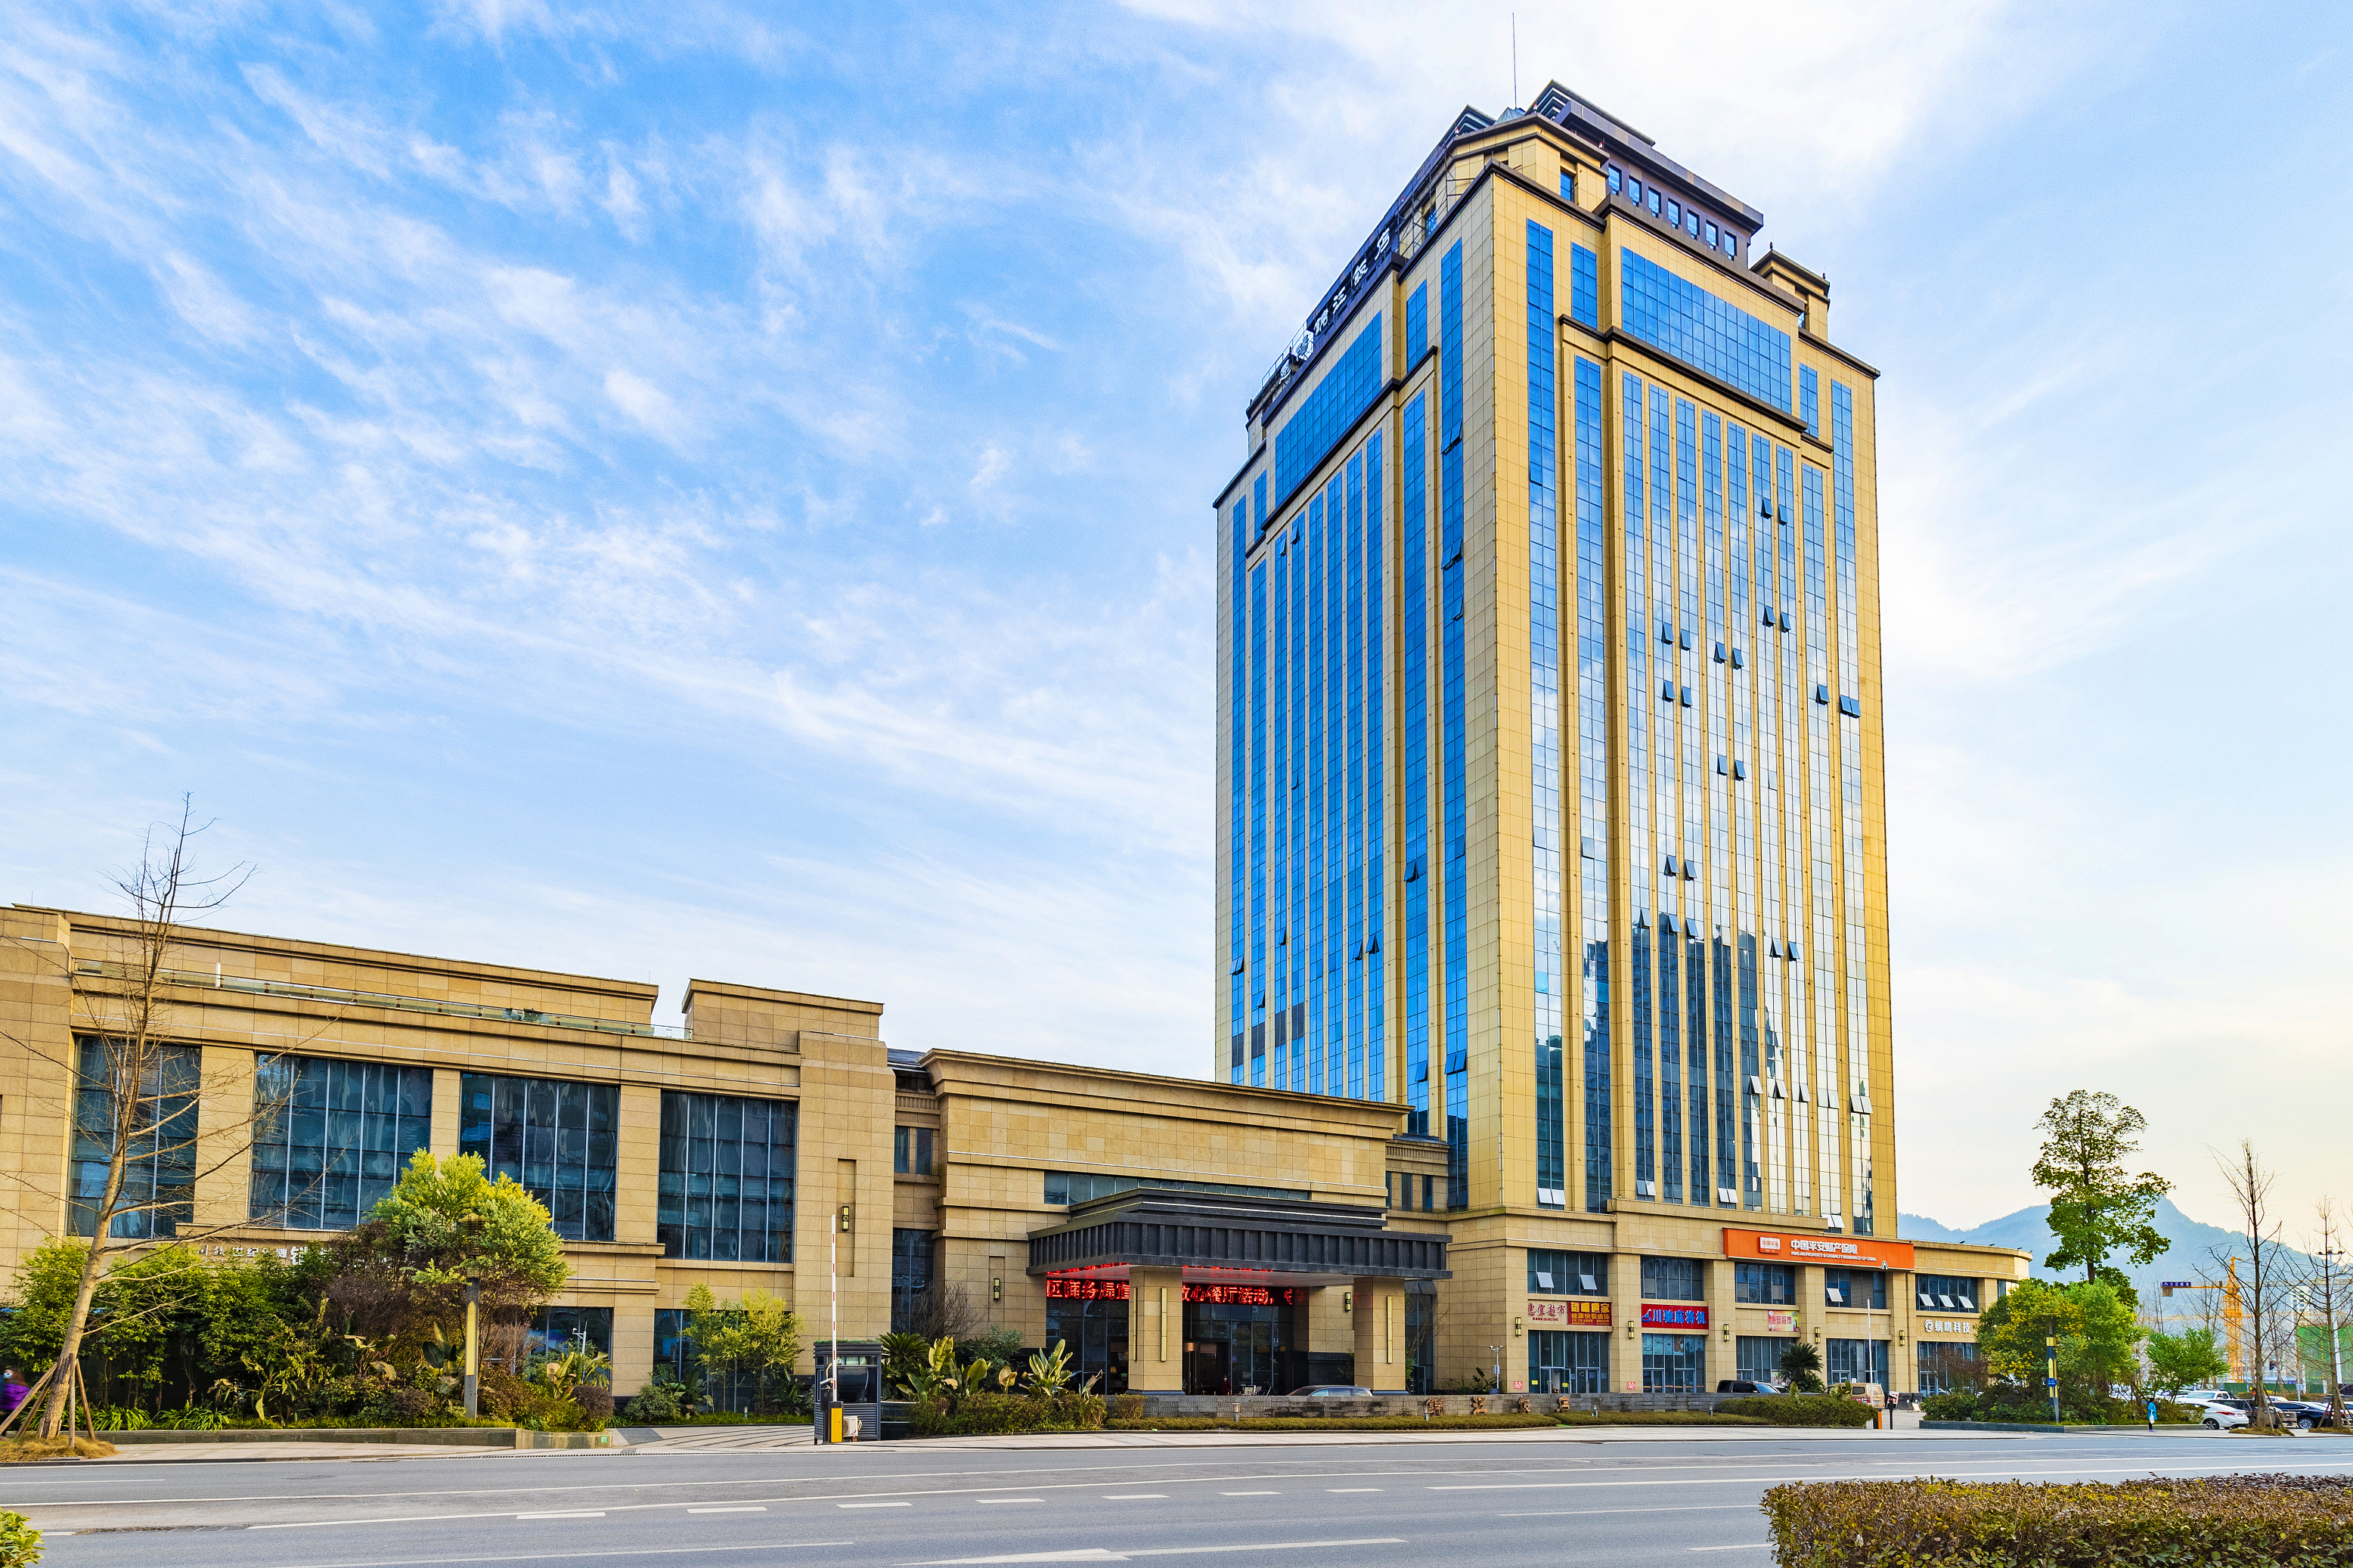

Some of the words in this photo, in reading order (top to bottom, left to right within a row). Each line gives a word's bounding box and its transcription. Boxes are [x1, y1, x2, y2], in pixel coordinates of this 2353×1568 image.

[1790, 1239, 1858, 1254] 中国平安财产保险
